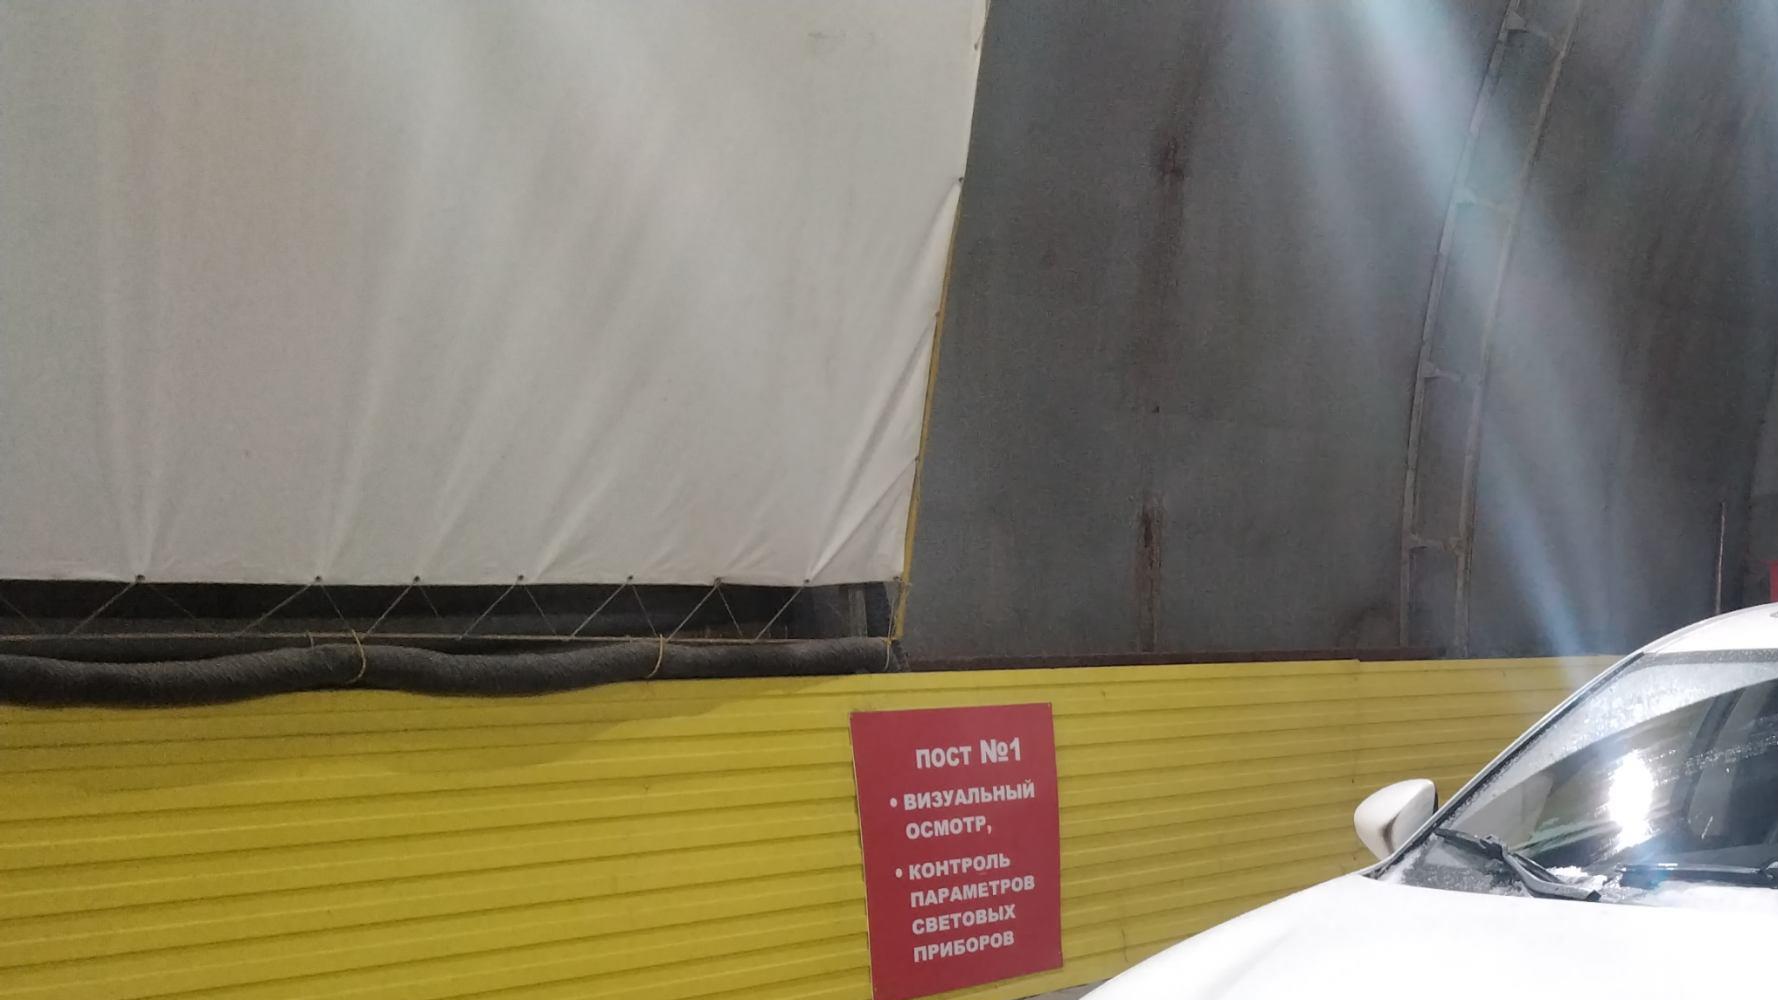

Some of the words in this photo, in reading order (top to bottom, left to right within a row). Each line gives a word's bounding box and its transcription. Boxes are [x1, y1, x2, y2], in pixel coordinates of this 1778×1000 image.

[915, 745, 972, 769] ПОСТ
[979, 737, 1021, 764] №1
[903, 779, 1035, 811] ВИЗУАЛЬНЫЙ
[905, 816, 992, 840] ОСМОТР,
[908, 853, 1011, 880] КОНТРОЛЬ
[910, 875, 1035, 908] ПАРАМЕТРОВ
[911, 904, 1016, 935] СВЕТОВЫХ
[913, 930, 1015, 962] ПРИБОРОВ
